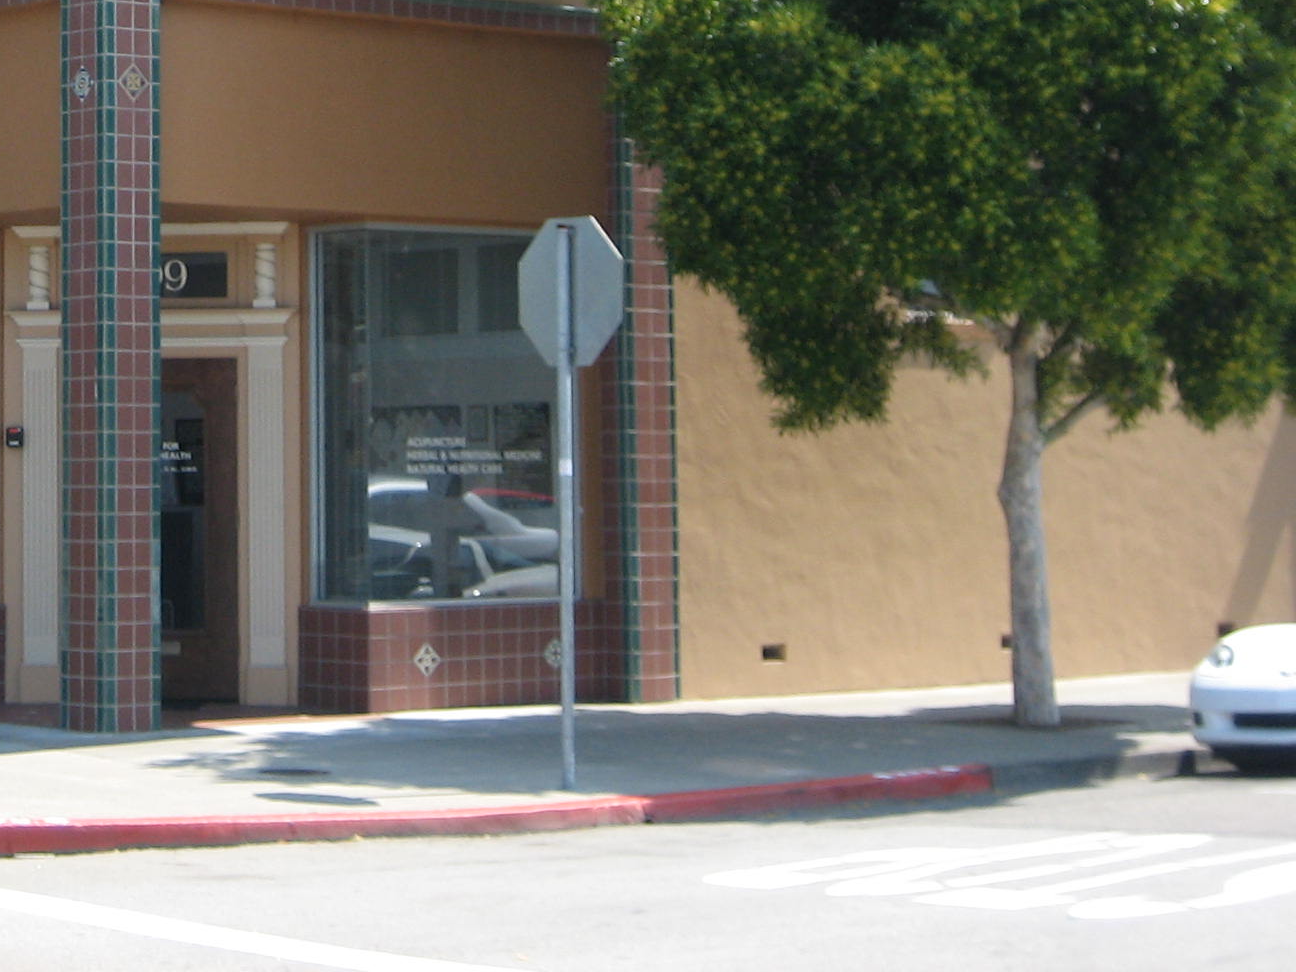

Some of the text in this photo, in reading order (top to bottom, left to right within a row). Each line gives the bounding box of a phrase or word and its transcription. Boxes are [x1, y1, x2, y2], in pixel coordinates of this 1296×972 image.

[160, 259, 188, 293] 9
[162, 441, 179, 450] FOR
[406, 436, 466, 448] ACUPUNCTURE
[406, 450, 438, 461] HERBAL
[448, 450, 501, 461] NUTRITIONAL
[503, 449, 542, 461] MEDICINE
[406, 462, 445, 474] NATURAL
[447, 462, 479, 474] HEALTH
